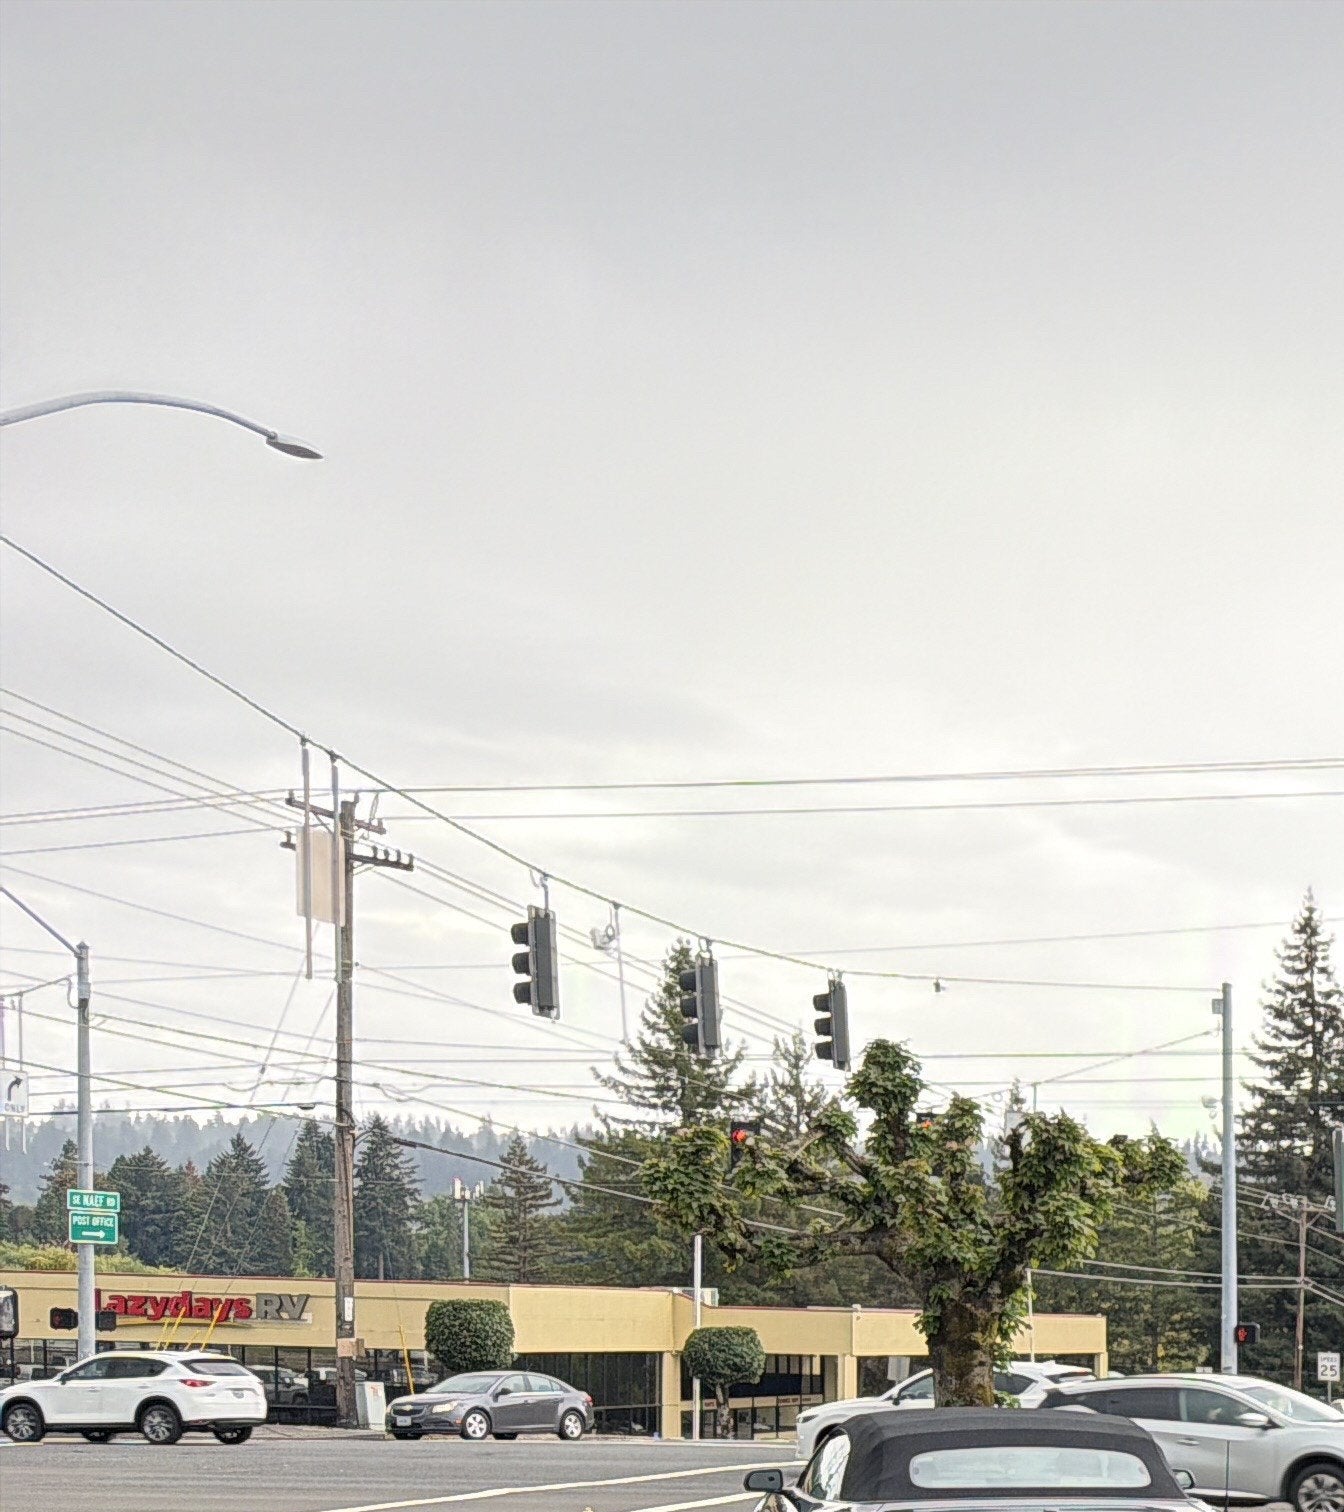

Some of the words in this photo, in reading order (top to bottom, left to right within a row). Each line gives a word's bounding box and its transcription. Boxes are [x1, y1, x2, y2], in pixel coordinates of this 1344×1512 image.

[72, 1215, 90, 1226] POST
[91, 1216, 115, 1228] OFFICE
[95, 1288, 254, 1322] Lazydays
[255, 1292, 311, 1321] RV
[1320, 1364, 1338, 1377] 25
